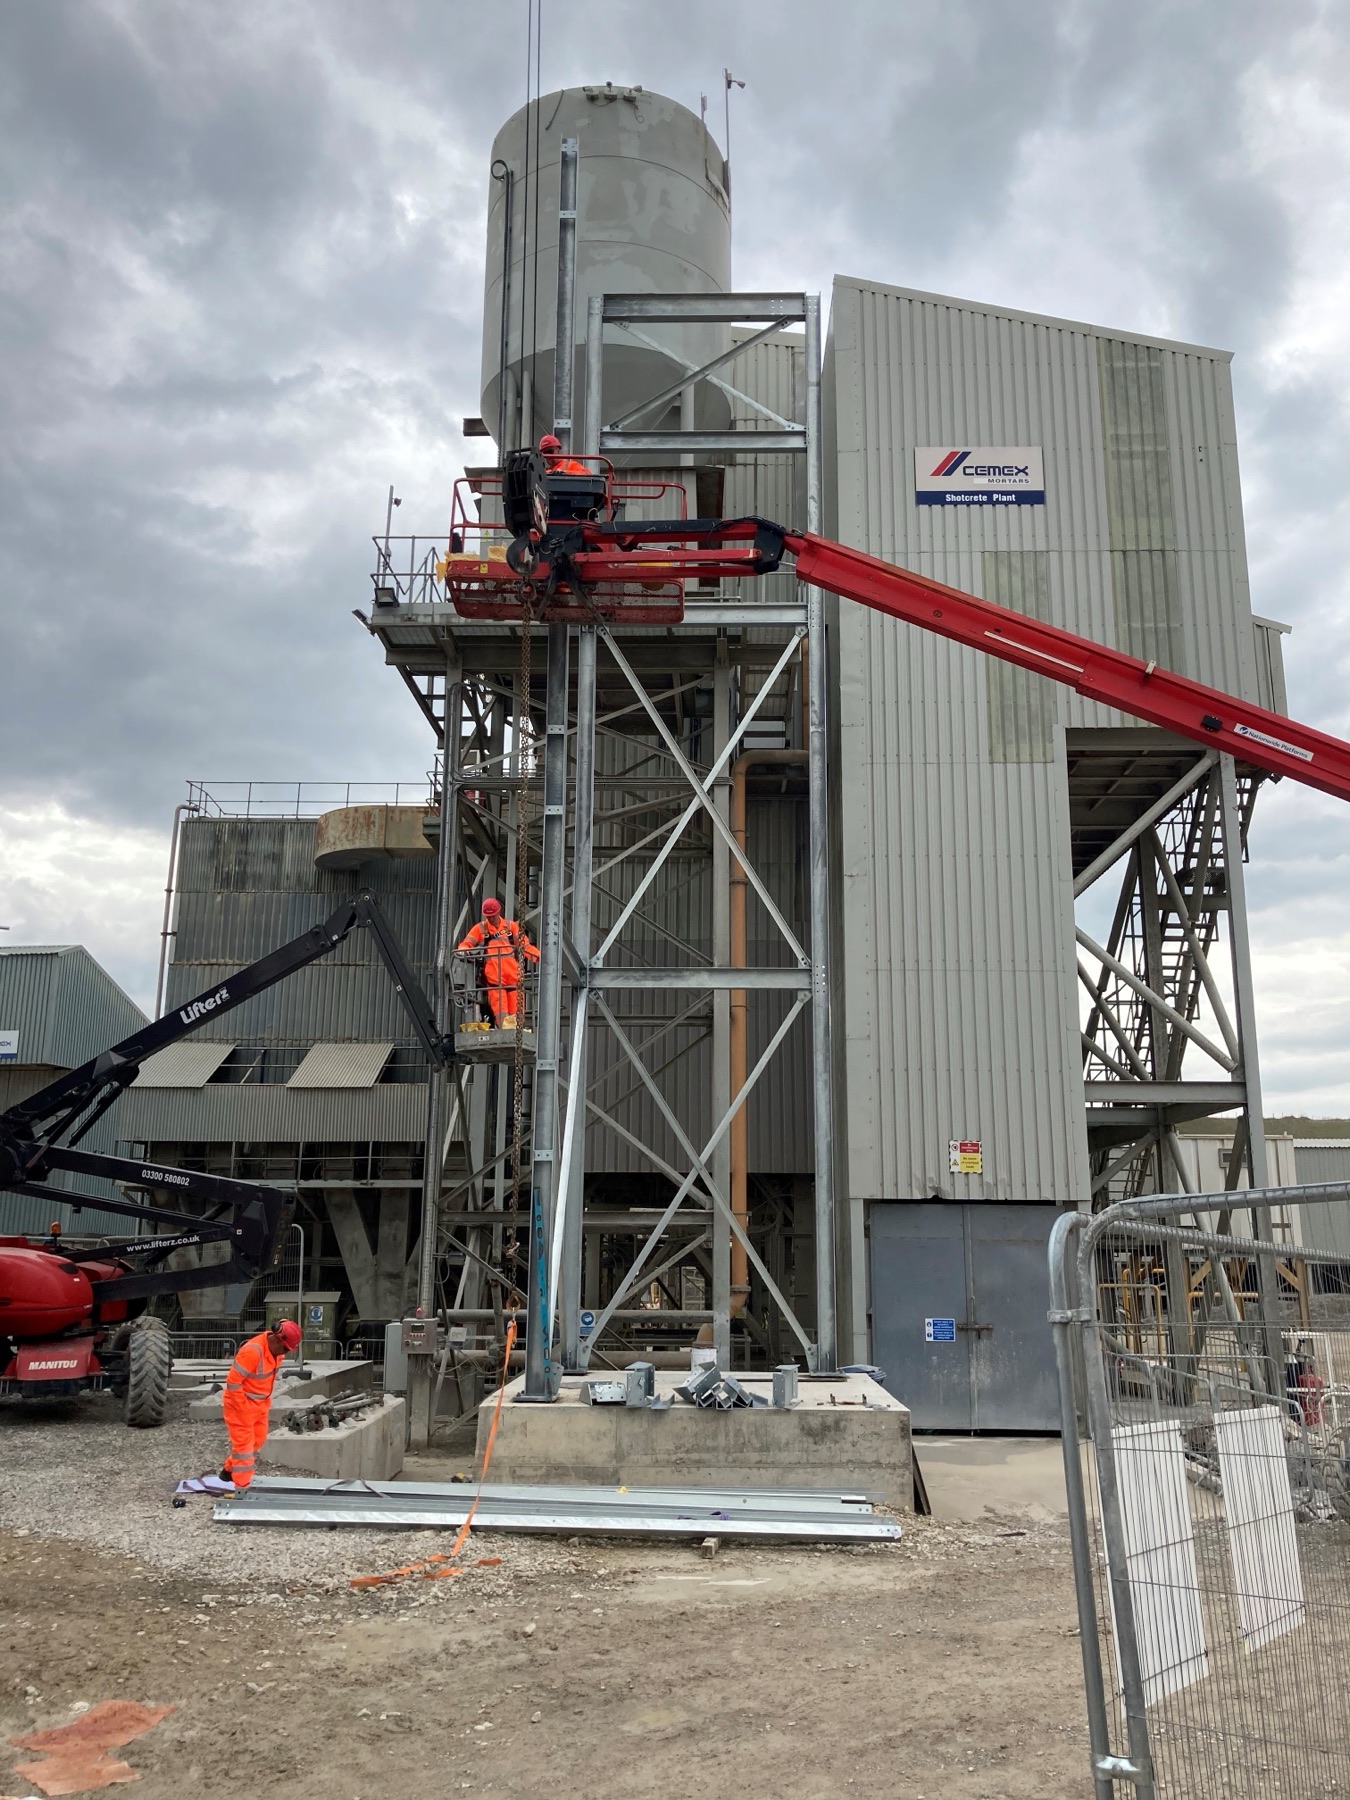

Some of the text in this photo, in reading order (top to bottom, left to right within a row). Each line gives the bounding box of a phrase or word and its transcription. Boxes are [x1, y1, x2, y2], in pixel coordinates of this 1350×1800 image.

[962, 465, 1029, 476] CEMEX
[945, 493, 1016, 502] Shotcrete Plant
[1248, 731, 1308, 759] Nationwide Platforms
[180, 986, 230, 1024] Lifterz
[141, 1169, 190, 1186] 03300 580802
[126, 1235, 200, 1252] www.lifterz.co.uk
[28, 1359, 78, 1370] MANITOU
